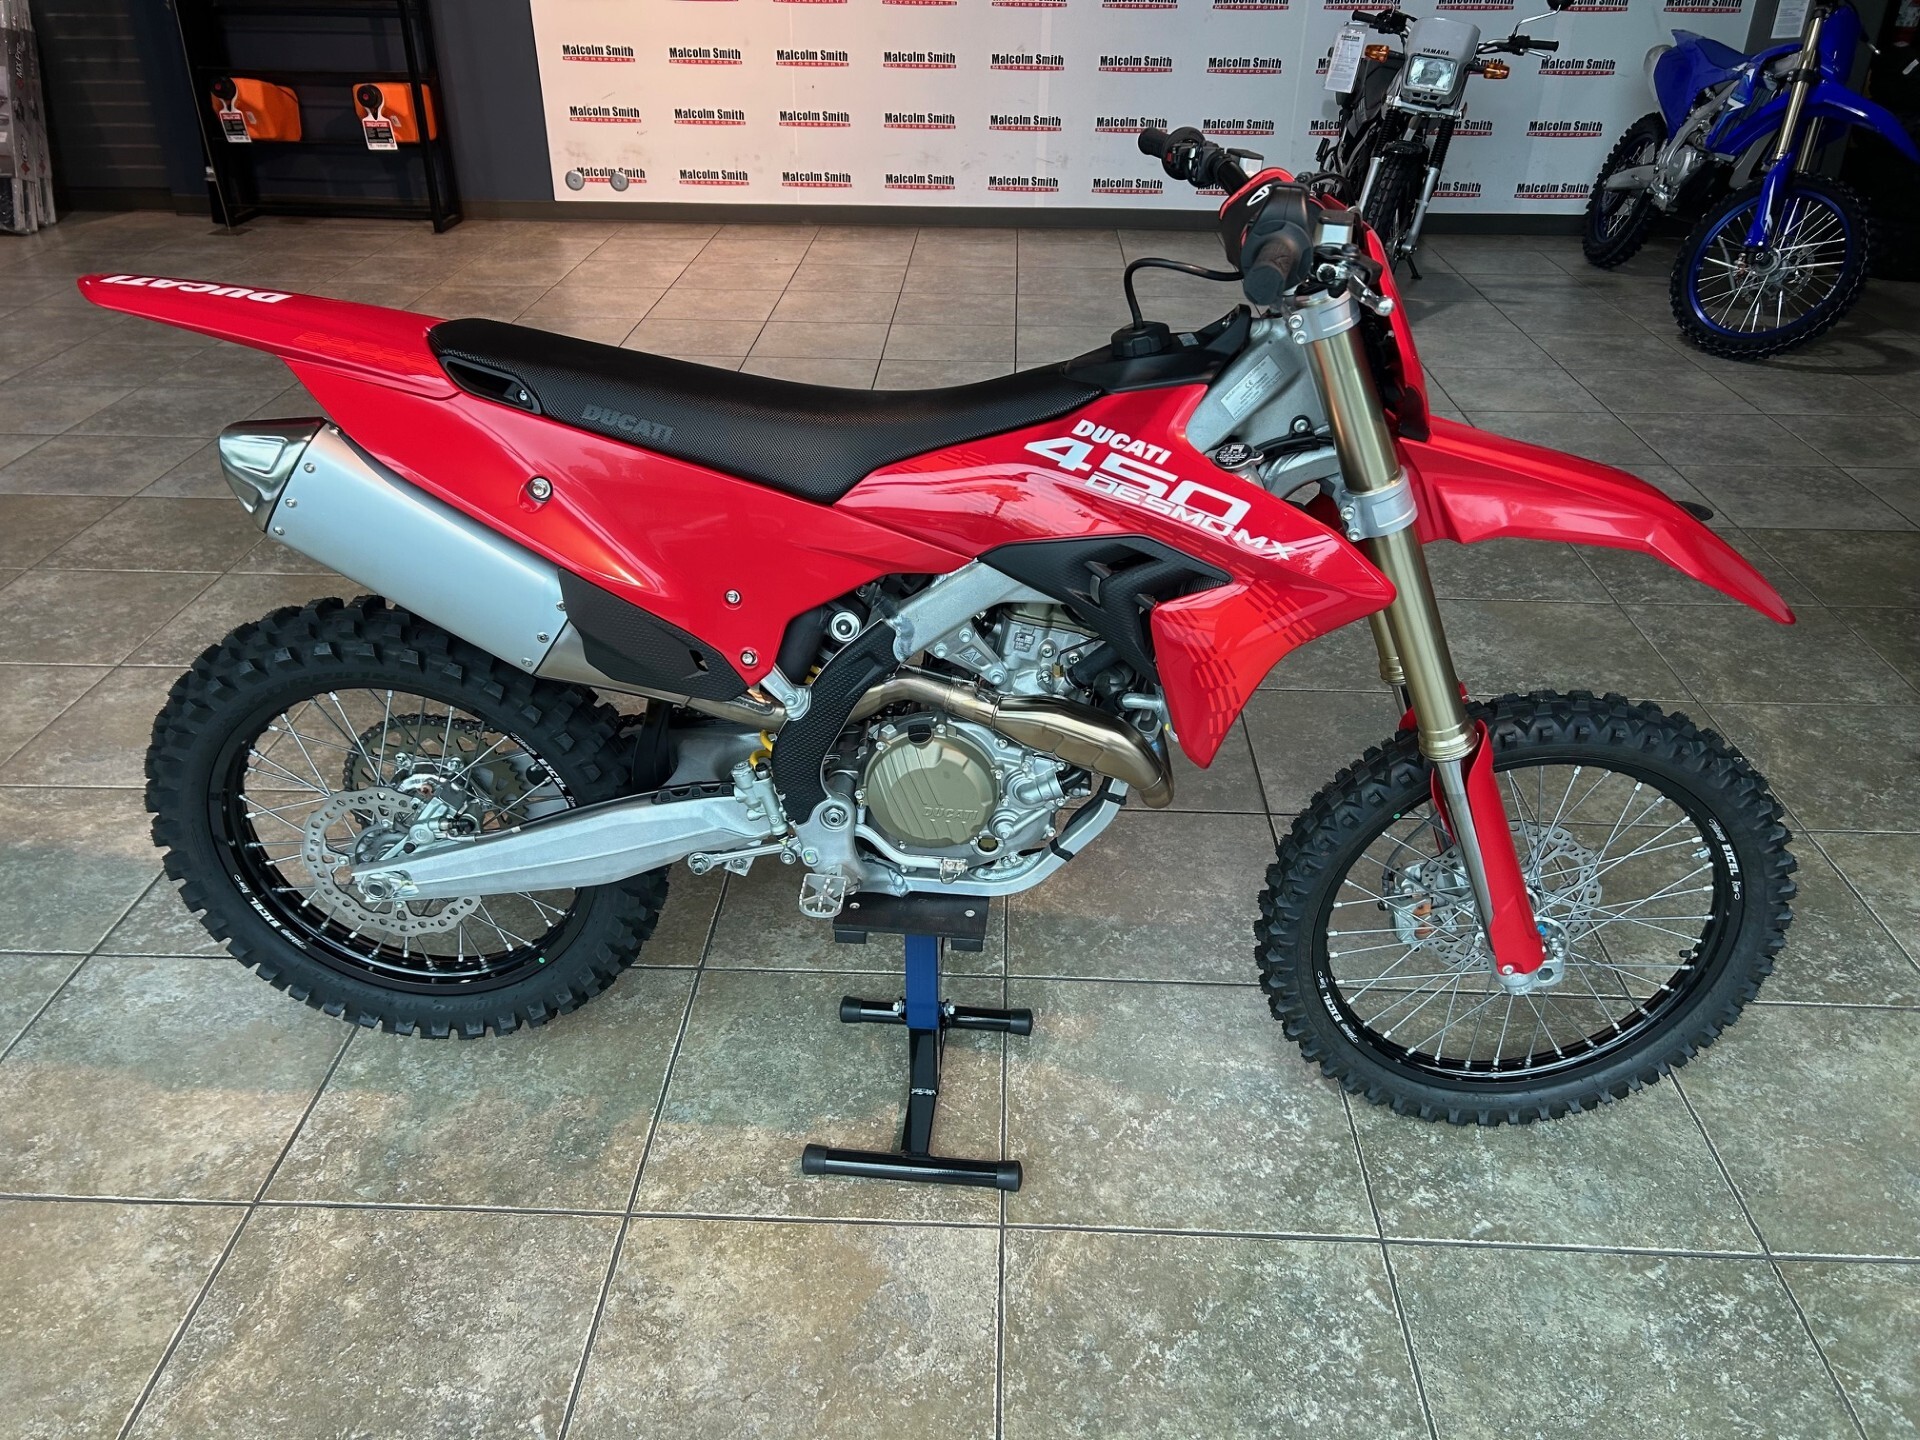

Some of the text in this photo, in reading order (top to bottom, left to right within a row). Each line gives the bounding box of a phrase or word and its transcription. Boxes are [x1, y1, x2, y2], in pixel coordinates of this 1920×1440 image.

[563, 45, 633, 56] Malcolm Smith
[670, 48, 740, 59] Malcolm Smith
[777, 50, 847, 61] Malcolm Smith
[884, 52, 955, 63] Malcolm Smith
[992, 54, 1064, 65] Malcolm Smith
[1100, 56, 1172, 67] Malcolm Smith
[1209, 58, 1281, 68] Malcolm Smith
[1540, 58, 1615, 70] Malcolm Smith
[570, 106, 639, 117] Malcolm Smith
[675, 109, 744, 120] Malcolm Smith
[780, 111, 849, 122] Malcolm Smith
[885, 113, 954, 124] Malcolm Smith
[991, 115, 1061, 126] Malcolm Smith
[1097, 117, 1167, 128] Malcolm Smith
[1204, 119, 1274, 130] Malcolm Smith
[1310, 120, 1340, 130] Malco
[1464, 120, 1492, 130] Smith
[1529, 121, 1602, 131] Malcolm Smith
[680, 170, 748, 180] Malcolm Smith
[783, 172, 850, 182] Malcolm Smith
[886, 174, 954, 184] Malcolm Smith
[990, 176, 1058, 187] Malcolm Smith
[1094, 178, 1162, 188] Malcolm Smith
[1453, 182, 1481, 192] Smith
[1517, 183, 1589, 193] Malcolm Smith
[100, 275, 293, 303] DUCATI
[582, 403, 674, 443] DUCATI
[1072, 419, 1172, 465] DUCATI
[1024, 436, 1251, 526] 450
[1085, 473, 1296, 560] DESMO MX
[538, 758, 566, 790] EXCEL
[922, 806, 978, 820] DUCATI
[1722, 844, 1739, 876] EXCEL
[250, 897, 281, 928] EXCEL
[1323, 992, 1343, 1022] EXCEL
